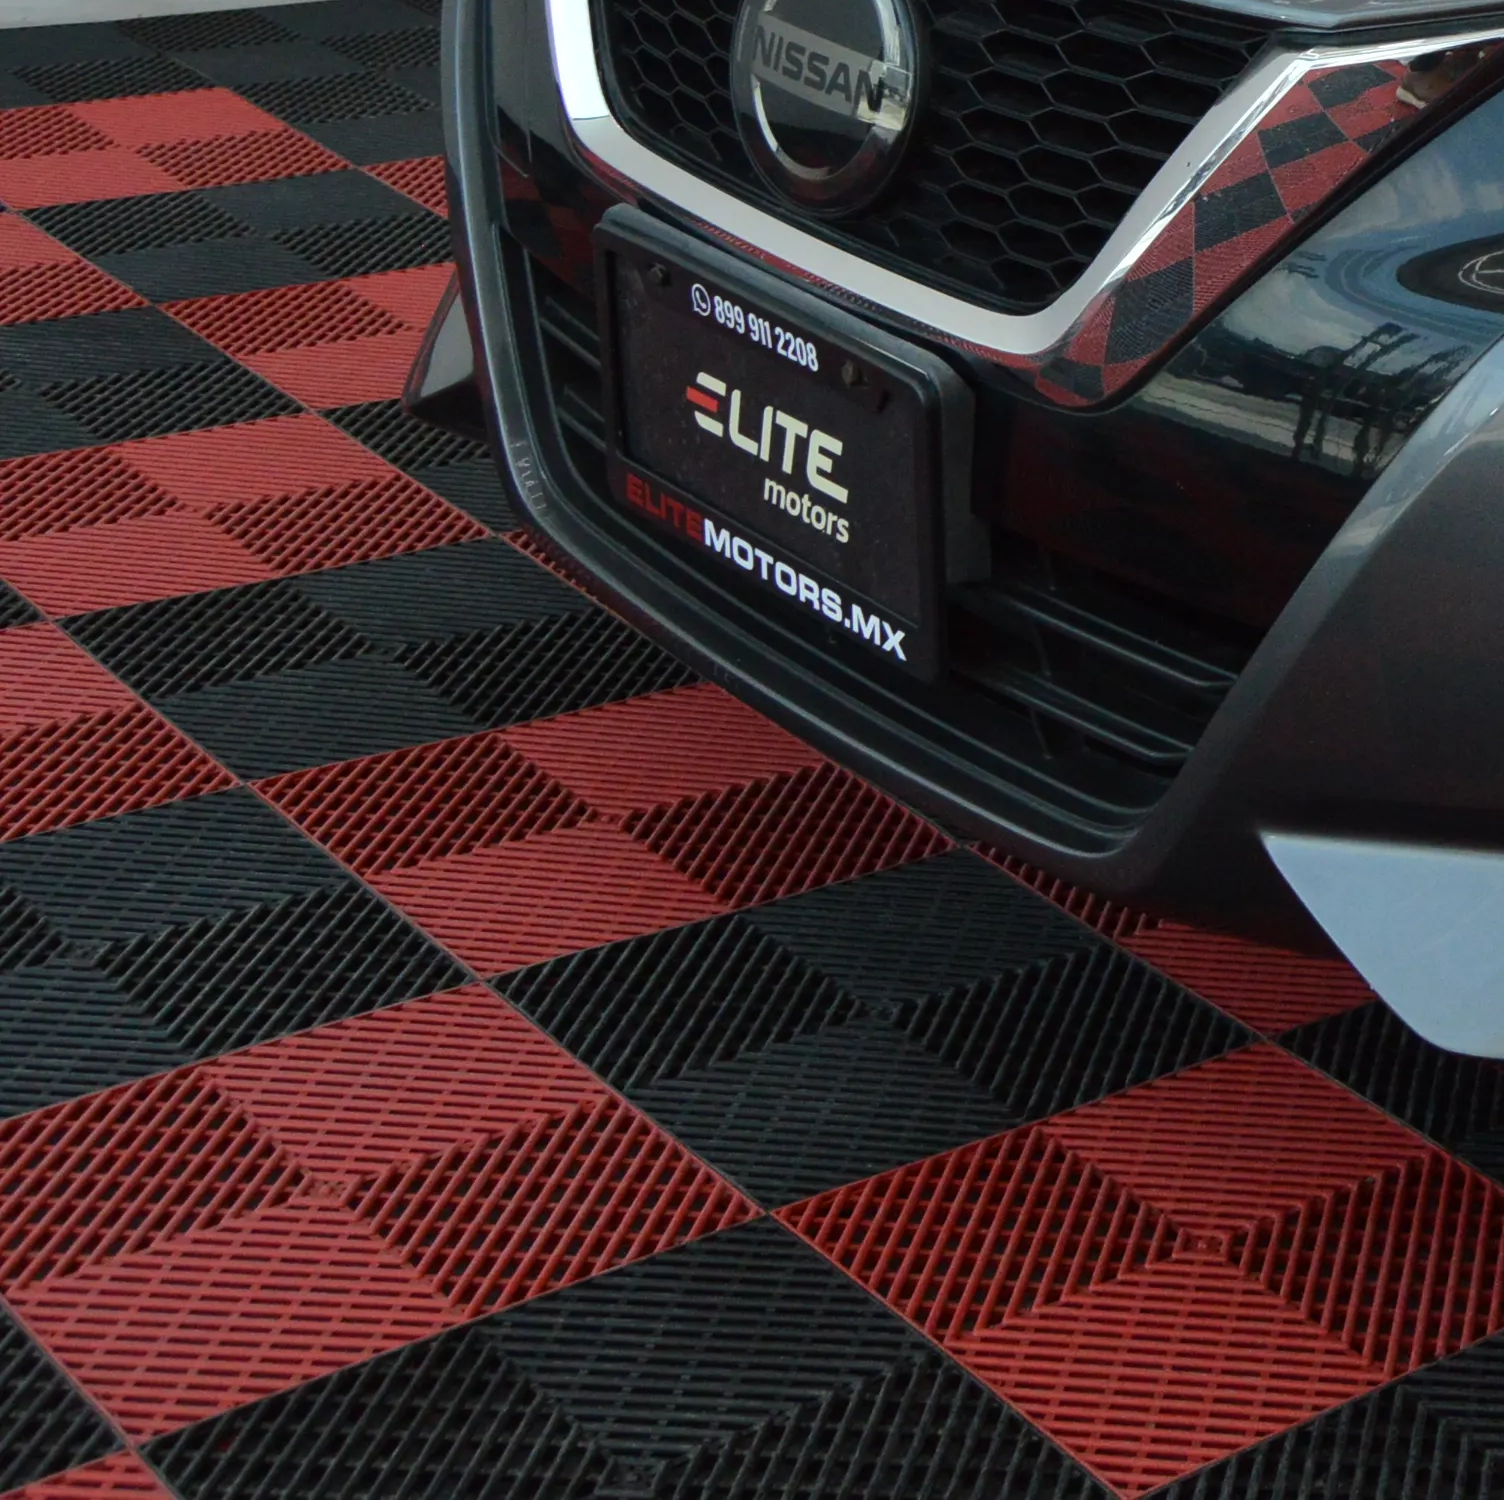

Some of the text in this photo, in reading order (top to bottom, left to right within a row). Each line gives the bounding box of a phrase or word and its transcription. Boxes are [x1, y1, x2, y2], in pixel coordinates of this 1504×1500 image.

[752, 24, 883, 113] NISSAN
[714, 295, 819, 372] 899 911 2208
[686, 371, 849, 504] ELITE
[764, 477, 850, 544] motors
